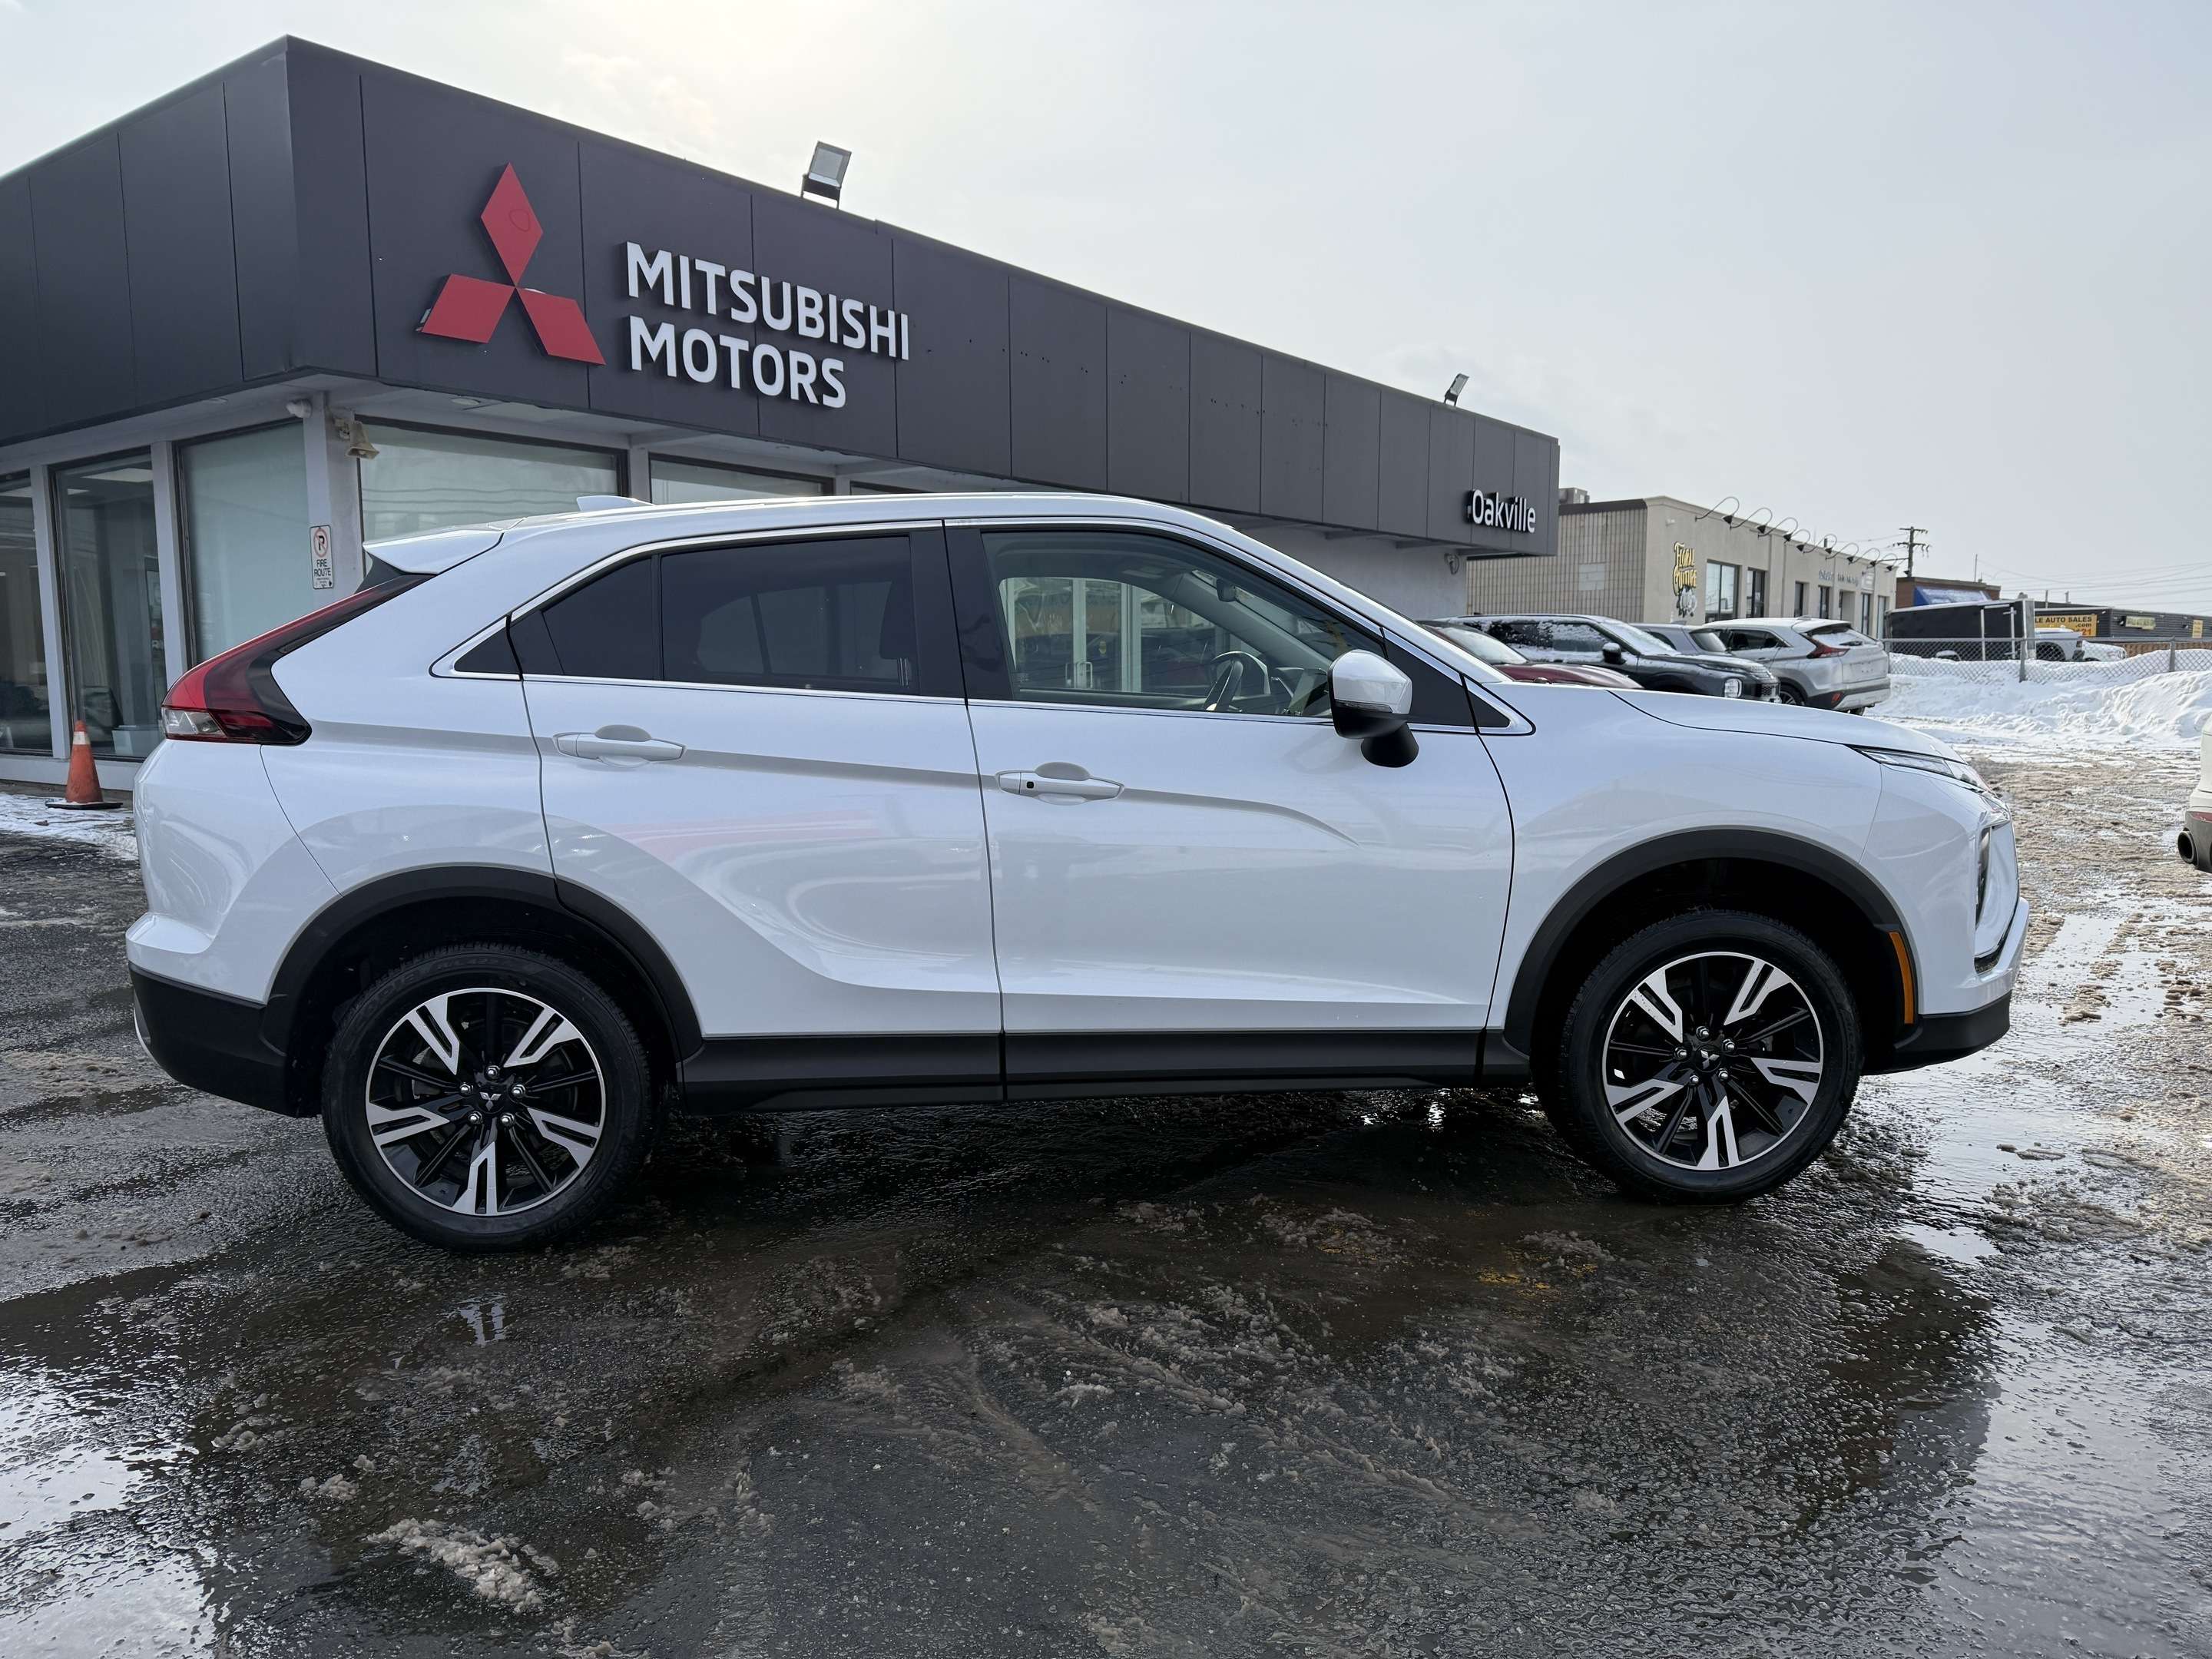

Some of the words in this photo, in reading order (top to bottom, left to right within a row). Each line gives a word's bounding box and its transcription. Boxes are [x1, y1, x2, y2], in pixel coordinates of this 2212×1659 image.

[626, 241, 909, 360] MITSUBISHI
[628, 315, 846, 409] MOTORS
[1472, 489, 1536, 533] Oakville
[314, 568, 331, 577] ROUTE
